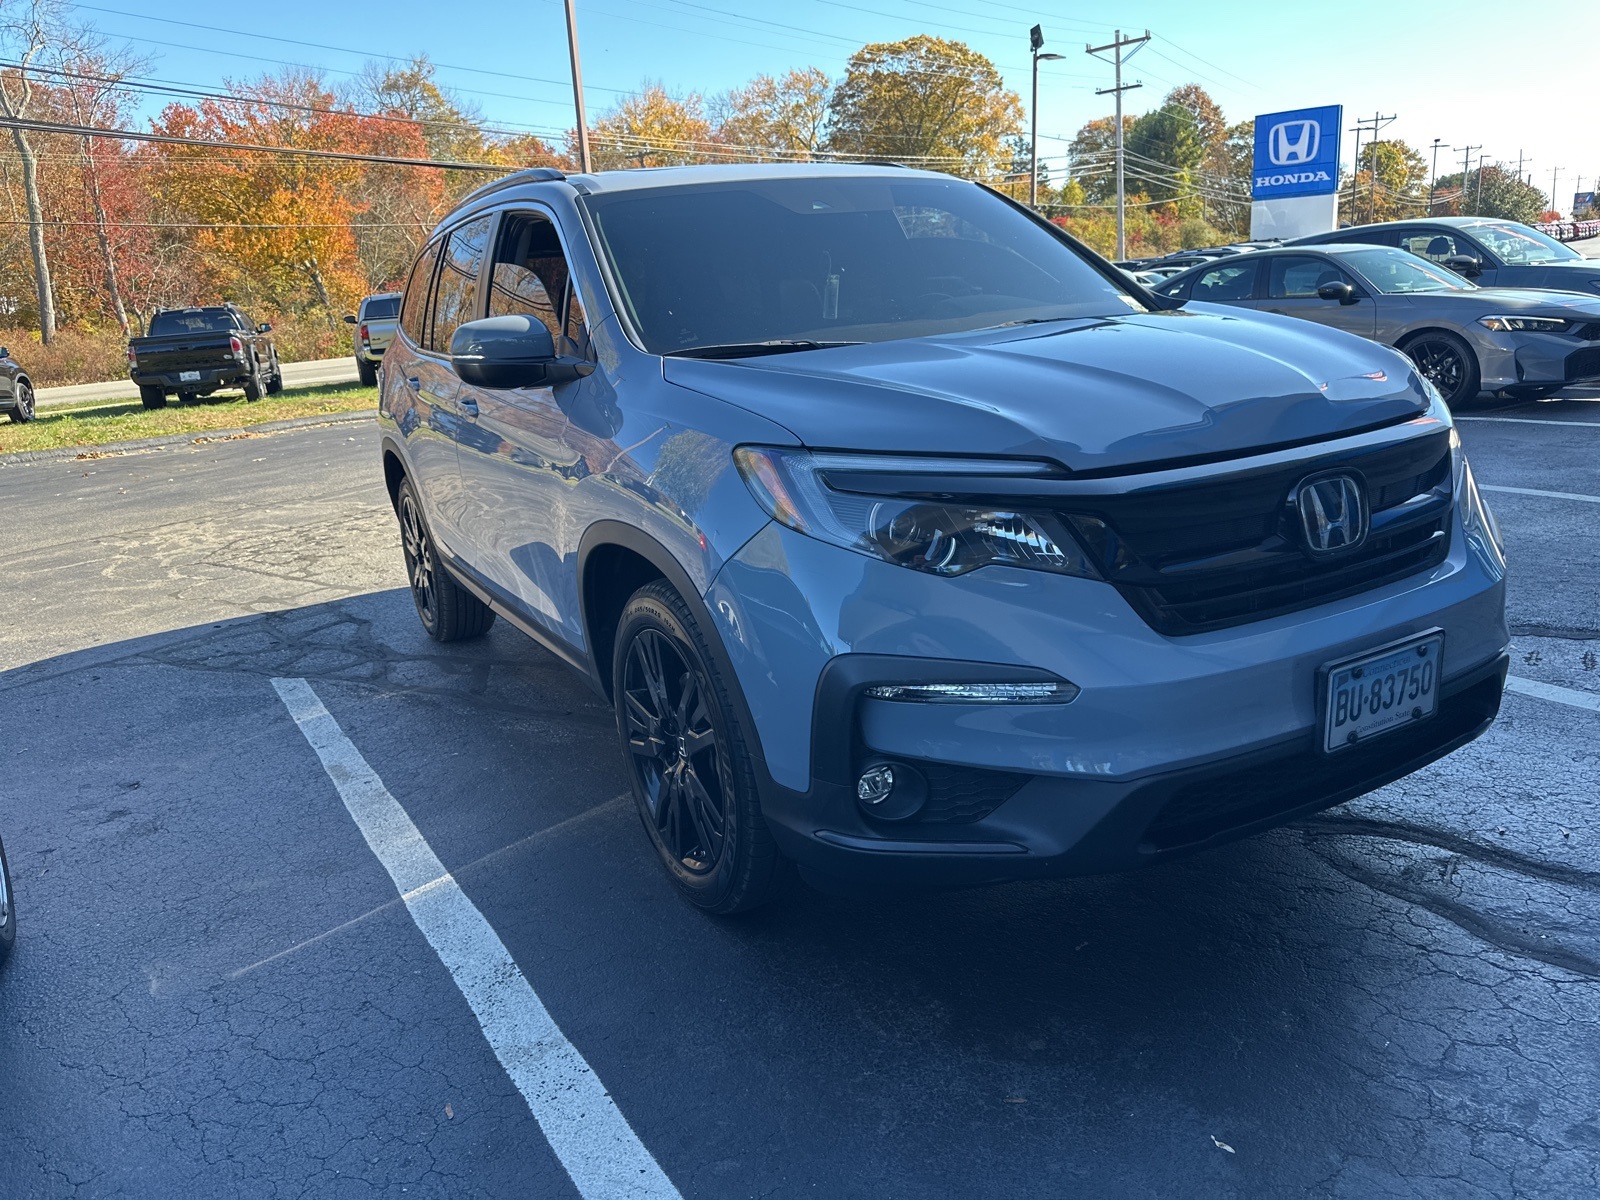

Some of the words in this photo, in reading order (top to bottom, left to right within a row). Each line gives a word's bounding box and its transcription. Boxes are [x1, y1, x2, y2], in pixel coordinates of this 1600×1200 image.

[1255, 171, 1331, 187] HONDA
[1362, 656, 1411, 678] Connecticut
[1355, 716, 1394, 734] Constitution
[1395, 710, 1411, 722] State
